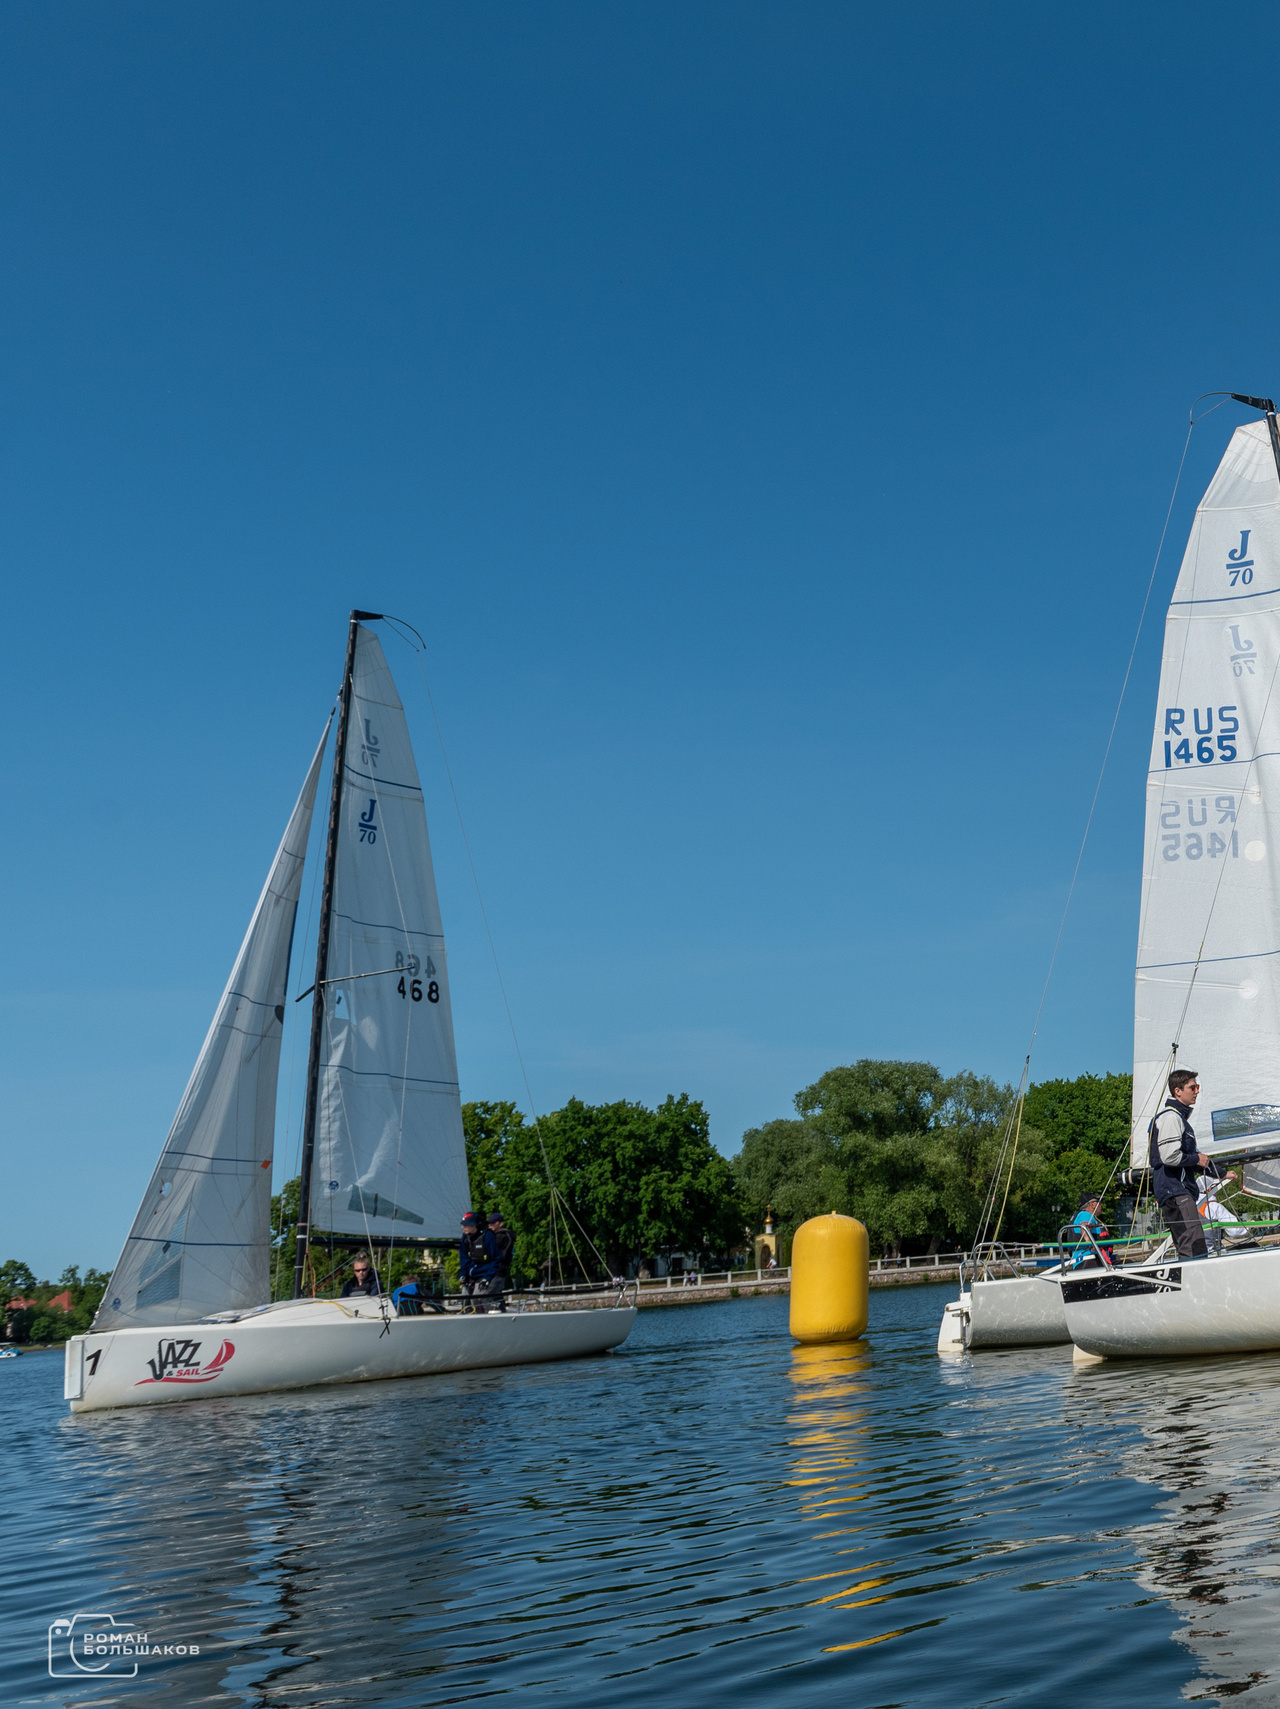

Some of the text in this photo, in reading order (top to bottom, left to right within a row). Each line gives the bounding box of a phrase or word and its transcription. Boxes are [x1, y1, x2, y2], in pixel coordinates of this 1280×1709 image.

[1228, 529, 1251, 561] J
[1229, 567, 1253, 587] 70
[1165, 705, 1239, 736] RUS
[1164, 734, 1237, 769] 1465
[361, 798, 377, 823] J
[359, 829, 377, 845] 70
[397, 975, 440, 1004] 468
[85, 1348, 103, 1376] 1
[146, 1338, 202, 1381] JAZZ
[176, 1368, 200, 1377] SAIL
